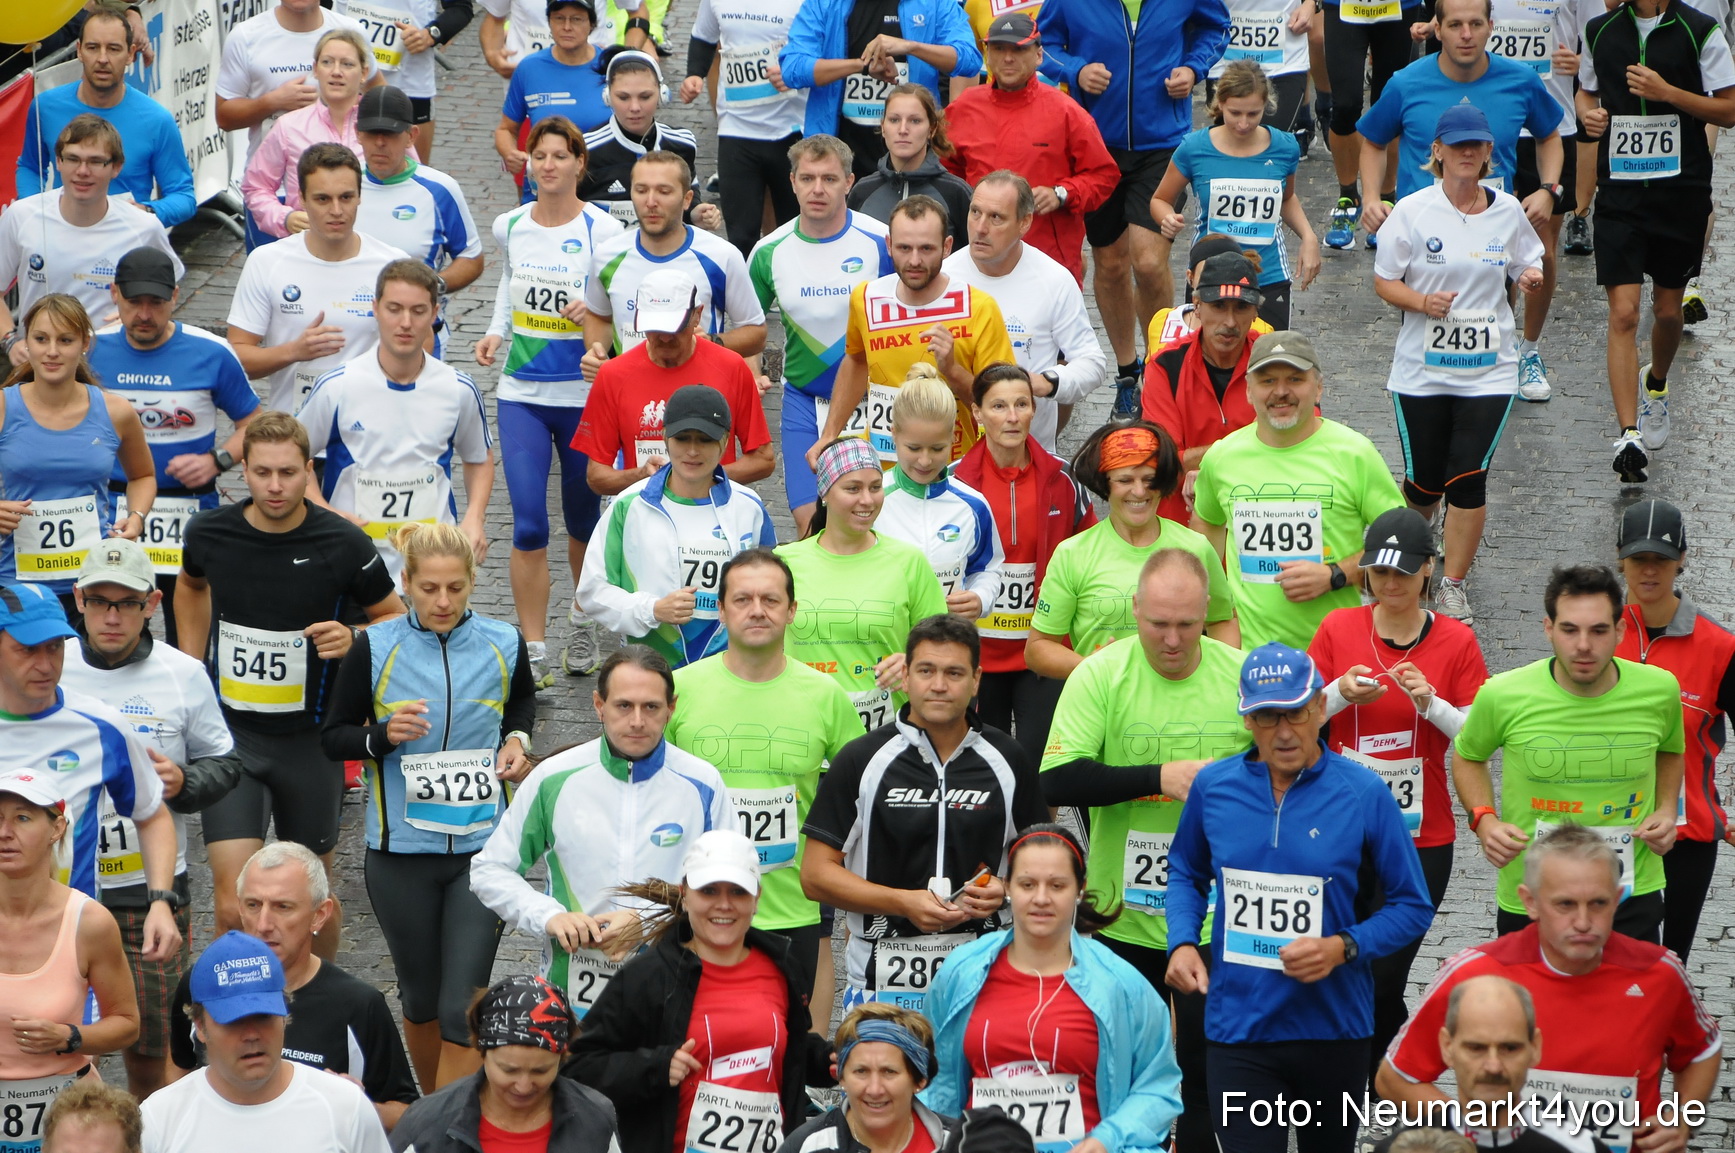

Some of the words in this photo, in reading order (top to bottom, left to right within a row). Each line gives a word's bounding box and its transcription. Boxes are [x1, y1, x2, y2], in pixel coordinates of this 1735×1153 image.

[348, 5, 368, 16] PARTL
[1353, 5, 1388, 17] Siegfried
[721, 12, 784, 24] www.hasit.de
[1229, 26, 1279, 47] 2552
[1491, 35, 1546, 57] 2875
[373, 51, 391, 63] ang
[727, 59, 768, 84] 3066
[1617, 131, 1674, 154] 2876
[1623, 160, 1666, 171] Christoph
[1216, 194, 1275, 219] 2619
[1227, 222, 1258, 234] Sandra
[514, 274, 534, 283] PARTL
[536, 276, 570, 287] Neumarkt
[800, 285, 851, 298] Michael
[525, 286, 568, 314] 426
[526, 316, 567, 330] Manuela
[1452, 315, 1486, 324] Neumarkt
[870, 333, 912, 351] MAX
[920, 325, 972, 344] BGL
[1432, 326, 1490, 350] 2431
[1440, 356, 1482, 366] Adelheid
[870, 390, 888, 400] PARTL
[358, 478, 384, 488] PARTL
[386, 478, 424, 488] Neumarkt
[42, 506, 83, 516] Neumarkt
[382, 490, 414, 518] 27
[39, 519, 75, 550] 26
[1242, 522, 1314, 552] 2493
[690, 547, 730, 557] Neumarkt
[36, 556, 81, 569] Daniela
[684, 559, 727, 588] 79
[994, 616, 1032, 628] Kerstin
[221, 630, 244, 643] PARTL
[246, 636, 290, 648] Neumarkt
[232, 646, 286, 681] 545
[1249, 664, 1292, 680] ITALIA
[1373, 738, 1398, 748] DEHN
[404, 762, 435, 772] PARTL
[437, 759, 478, 769] Neumarkt
[416, 771, 492, 801] 3128
[740, 796, 782, 806] Neumarkt
[884, 788, 990, 804] SILVINI
[1531, 797, 1584, 814] MERZ
[1128, 840, 1160, 850] PARTL
[1226, 878, 1253, 890] PARTL
[1256, 882, 1303, 894] Neumarkt
[1234, 894, 1310, 934] 2158
[880, 942, 912, 952] PARTL
[572, 954, 601, 968] PARTL
[281, 1048, 324, 1064] PFLEIDERER
[729, 1056, 757, 1070] DEHN
[1008, 1065, 1034, 1078] DEHN
[8, 1086, 58, 1099] Neumarkt
[976, 1088, 1008, 1098] PARTL
[1010, 1086, 1061, 1098] Neumarkt
[1527, 1080, 1558, 1092] ARTL
[1562, 1083, 1616, 1096] Neumarkt
[698, 1092, 732, 1108] PARTL
[697, 1110, 777, 1153] 2278
